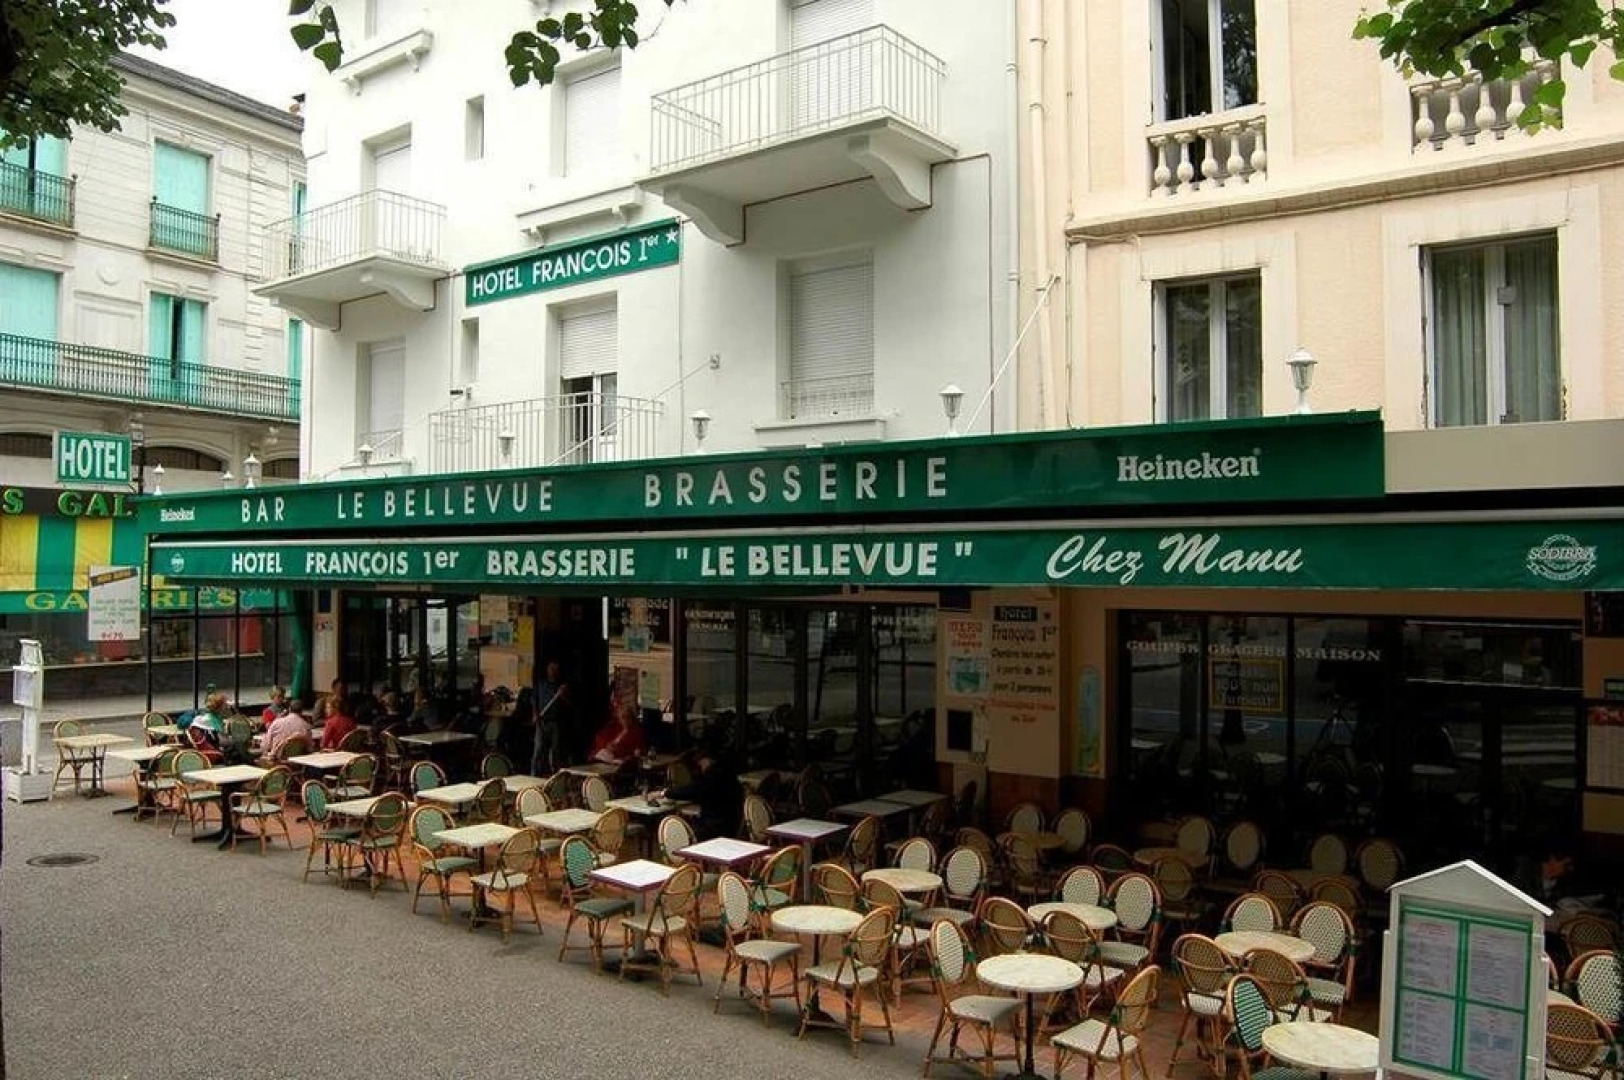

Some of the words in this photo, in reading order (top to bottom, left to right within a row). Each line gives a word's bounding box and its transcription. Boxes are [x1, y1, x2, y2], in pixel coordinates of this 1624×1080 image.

[472, 266, 523, 298] HOTEL
[532, 241, 630, 285] FRANCOIS
[60, 438, 128, 480] HOTEL
[1117, 449, 1260, 482] Heineken
[241, 497, 285, 523] BAR
[337, 491, 364, 519] LE
[384, 480, 553, 517] BELLEVUE
[643, 456, 947, 508] BRASSERIE
[231, 551, 283, 574] HOTEL
[305, 551, 409, 576] FRANÇOIS
[423, 550, 460, 575] 1er
[486, 548, 635, 577] BRASSERIE
[701, 545, 735, 576] LE
[748, 542, 938, 576] BELLEVUE
[1046, 534, 1144, 586] Chez
[1158, 532, 1304, 574] Manu
[1294, 647, 1384, 662] MAISON
